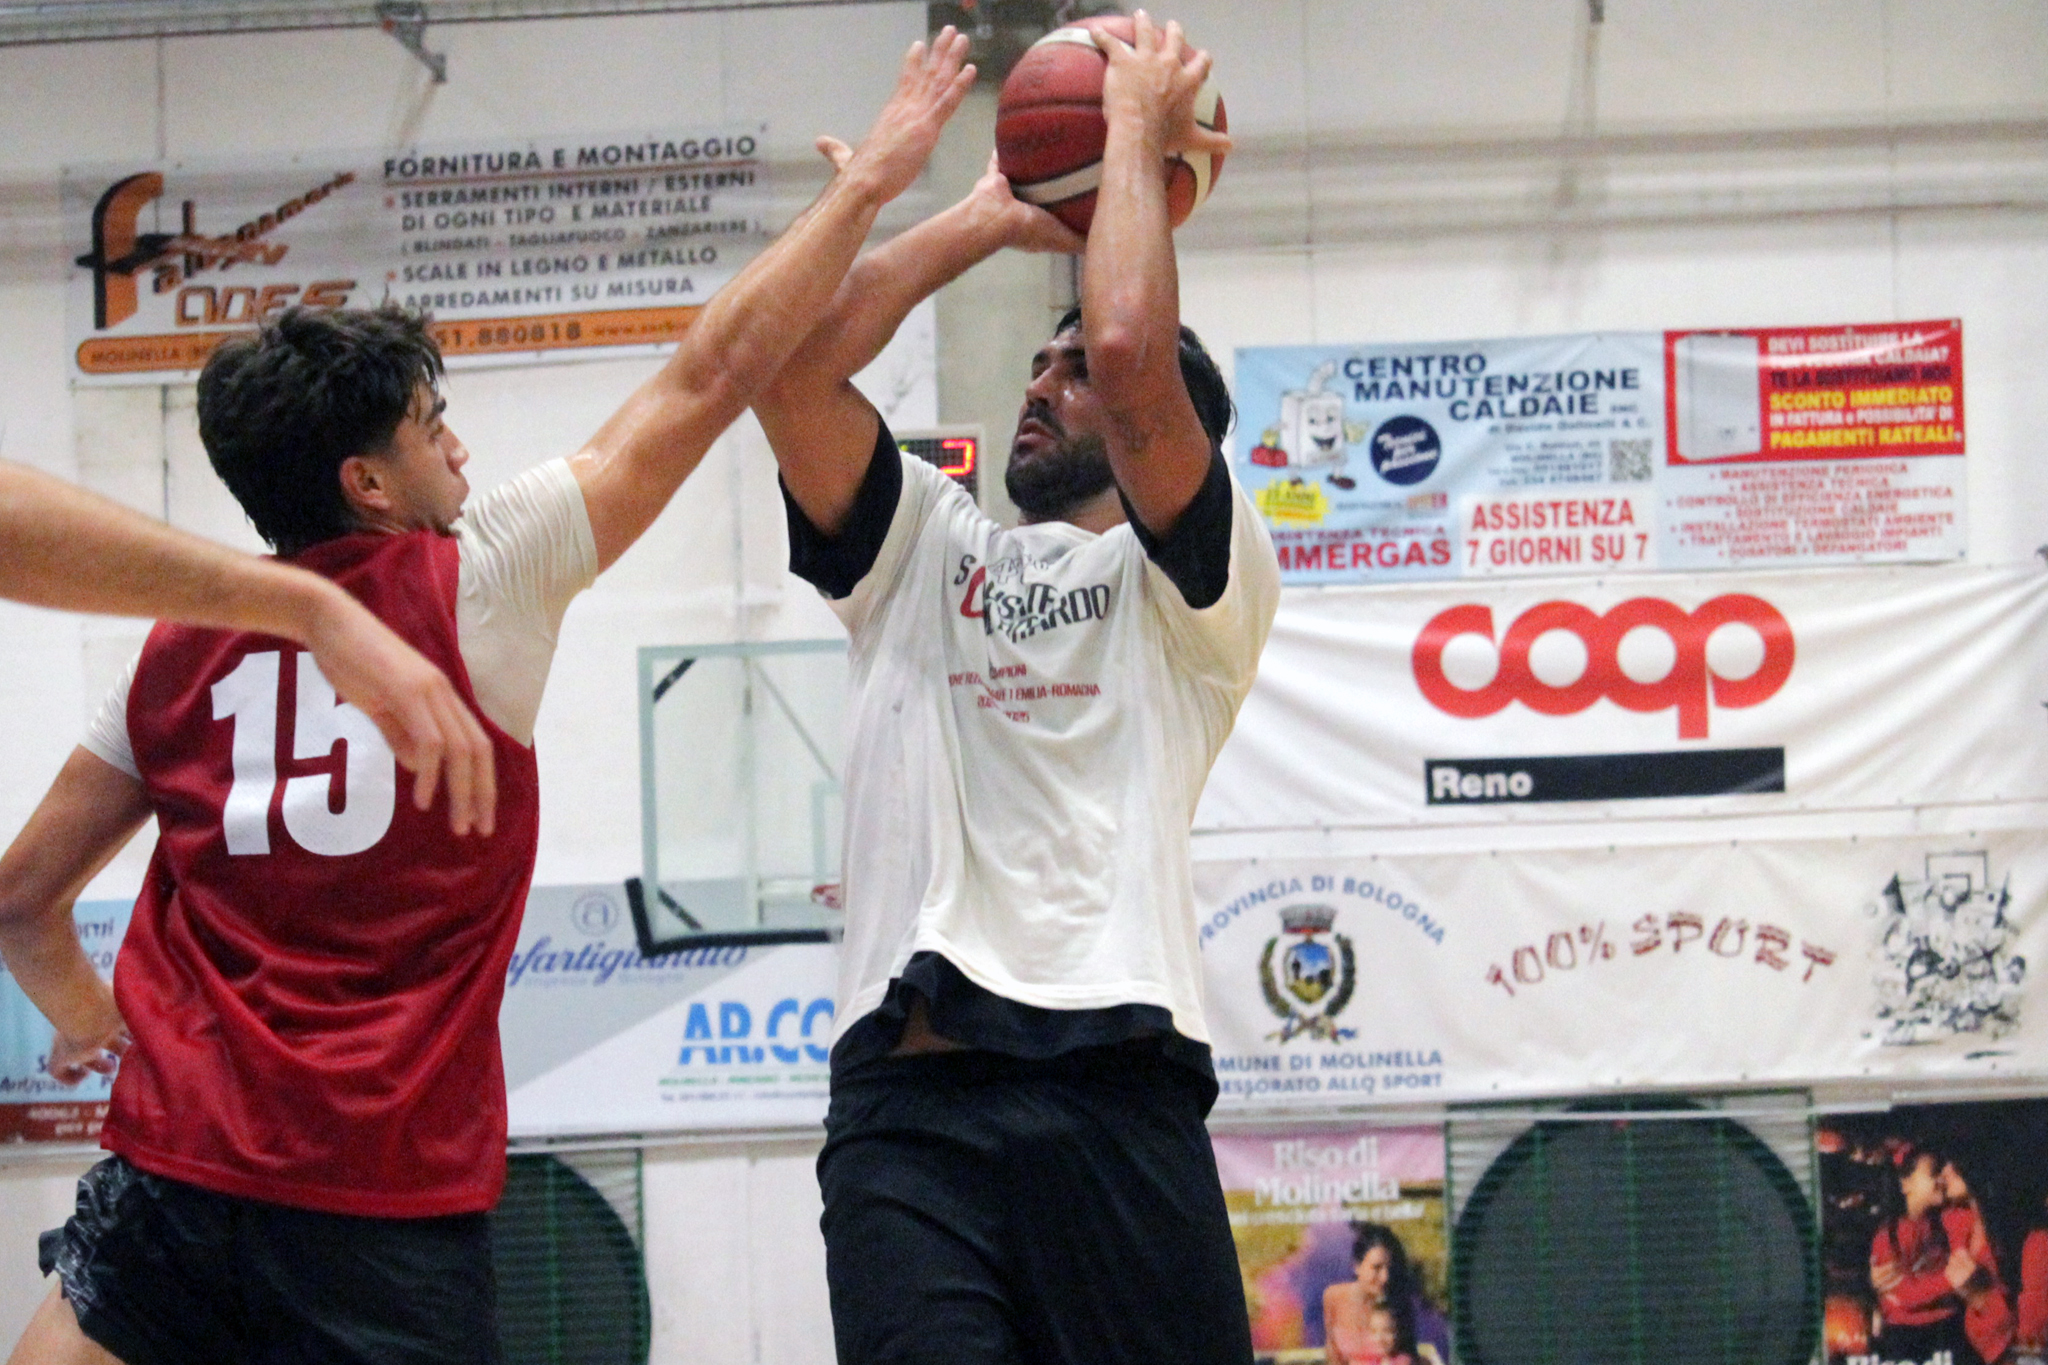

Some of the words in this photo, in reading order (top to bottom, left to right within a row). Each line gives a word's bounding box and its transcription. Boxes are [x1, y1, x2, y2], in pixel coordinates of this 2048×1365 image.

[384, 150, 541, 177] FORNITURA
[553, 148, 565, 168] E
[577, 136, 756, 165] MONTAGGIO
[402, 184, 539, 209] SERRAMENTI
[549, 178, 638, 199] INTERNI
[665, 171, 755, 192] ESTERNI
[402, 214, 424, 232] DI
[434, 210, 495, 230] OGNI
[504, 206, 555, 225] TIPO
[572, 204, 581, 222] E
[591, 195, 711, 219] MATERIALE
[403, 262, 466, 282] SCALE
[477, 260, 501, 277] IN
[511, 256, 588, 276] LEGNO
[599, 254, 607, 271] E
[617, 246, 717, 268] METALLO
[405, 286, 561, 308] ARREDAMENTI
[571, 284, 598, 300] SU
[607, 276, 693, 297] MISURA
[434, 321, 581, 347] 51.880818
[1344, 352, 1487, 380] CENTRO
[1354, 368, 1640, 402] MANUTENZIONE
[1769, 390, 1846, 410] SCONTO
[1849, 386, 1953, 407] IMMEDIATO
[1448, 392, 1600, 421] CALDAIE
[1769, 427, 1875, 448] PAGAMENTI
[1878, 425, 1954, 444] RATEALI
[1472, 498, 1635, 531] ASSISTENZA
[1277, 539, 1451, 570] MMERGAS
[1466, 538, 1480, 566] 7
[1489, 536, 1581, 566] GIORNI
[1591, 533, 1625, 562] SU
[1635, 532, 1649, 561] 7
[1411, 592, 1796, 740] coop
[210, 650, 396, 857] 15
[1431, 766, 1534, 798] Reno
[1198, 878, 1303, 950] ROVINCIA
[1311, 875, 1334, 892] DI
[1343, 877, 1446, 945] BOLOGNA
[1485, 920, 1616, 997] 100%
[1630, 911, 1837, 983] SPORT
[1213, 1054, 1280, 1071] MUNE
[1290, 1054, 1312, 1070] DI
[1319, 1050, 1442, 1069] MOLINELLA
[1220, 1077, 1320, 1094] ESSORATO
[1383, 1073, 1442, 1089] SPORT
[1273, 1139, 1343, 1169] Riso
[1349, 1135, 1378, 1167] di
[1254, 1171, 1399, 1206] Molinella
